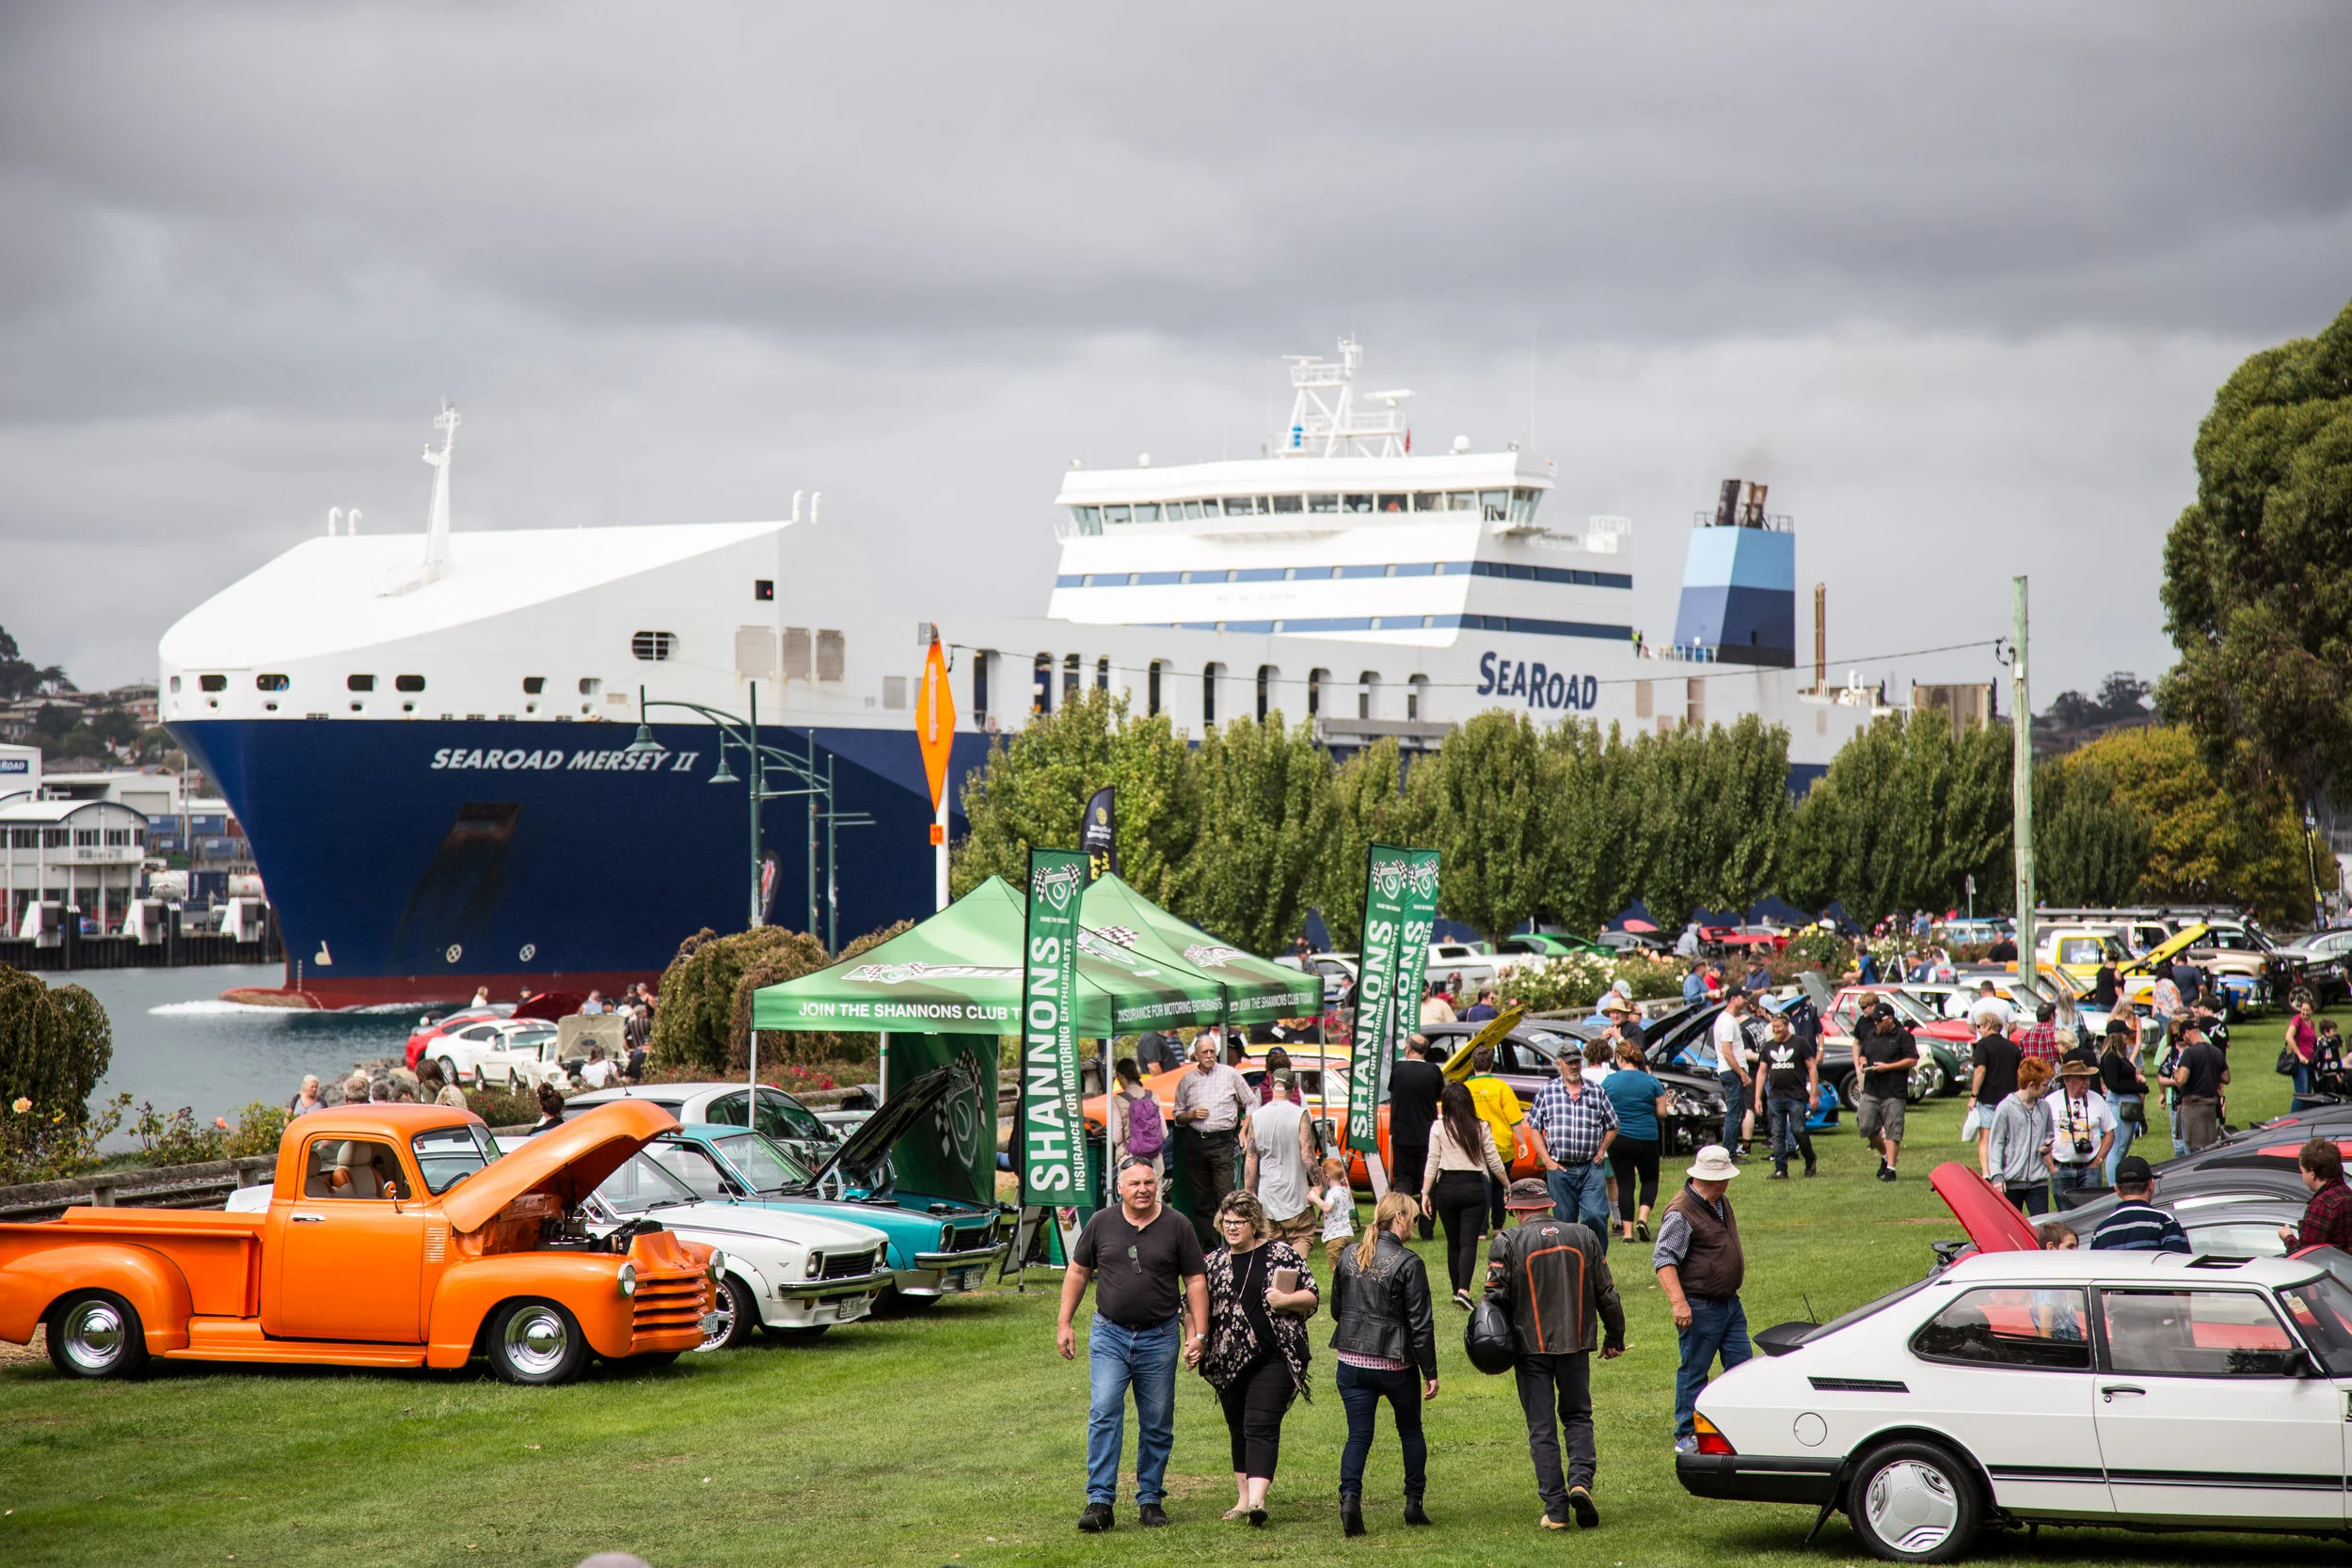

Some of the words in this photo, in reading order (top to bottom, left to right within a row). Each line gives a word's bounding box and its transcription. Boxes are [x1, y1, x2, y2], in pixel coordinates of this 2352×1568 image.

[1, 760, 25, 770] ROAD
[430, 749, 564, 770] SEAROAD
[566, 751, 671, 772] MERSEY
[670, 752, 700, 772] II
[1059, 938, 1072, 1022] ENTHUSIASTS
[1381, 924, 1400, 995] ENTHUSIASTS
[799, 1003, 835, 1017] JOIN
[838, 1004, 870, 1018] THE
[874, 1004, 962, 1019] SHANNONS
[966, 1005, 1009, 1021] CLUB
[1152, 1005, 1164, 1017] FOR
[1164, 1001, 1192, 1016] MOTORING
[1192, 997, 1223, 1013] ENTHUSIASTS
[1239, 999, 1251, 1011] JOIN
[1251, 997, 1262, 1009] THE
[1262, 994, 1287, 1008] SHANNONS
[1287, 992, 1299, 1006] CLUB
[1351, 919, 1392, 1138] SHANNONS
[1371, 996, 1387, 1053] MOTORING
[1027, 936, 1070, 1192] SHANNONS
[1059, 1025, 1075, 1089] MOTORING
[1069, 1094, 1077, 1119] FOR
[1369, 1078, 1379, 1140] INSURANCE
[1073, 1120, 1086, 1192] INSURANCE
